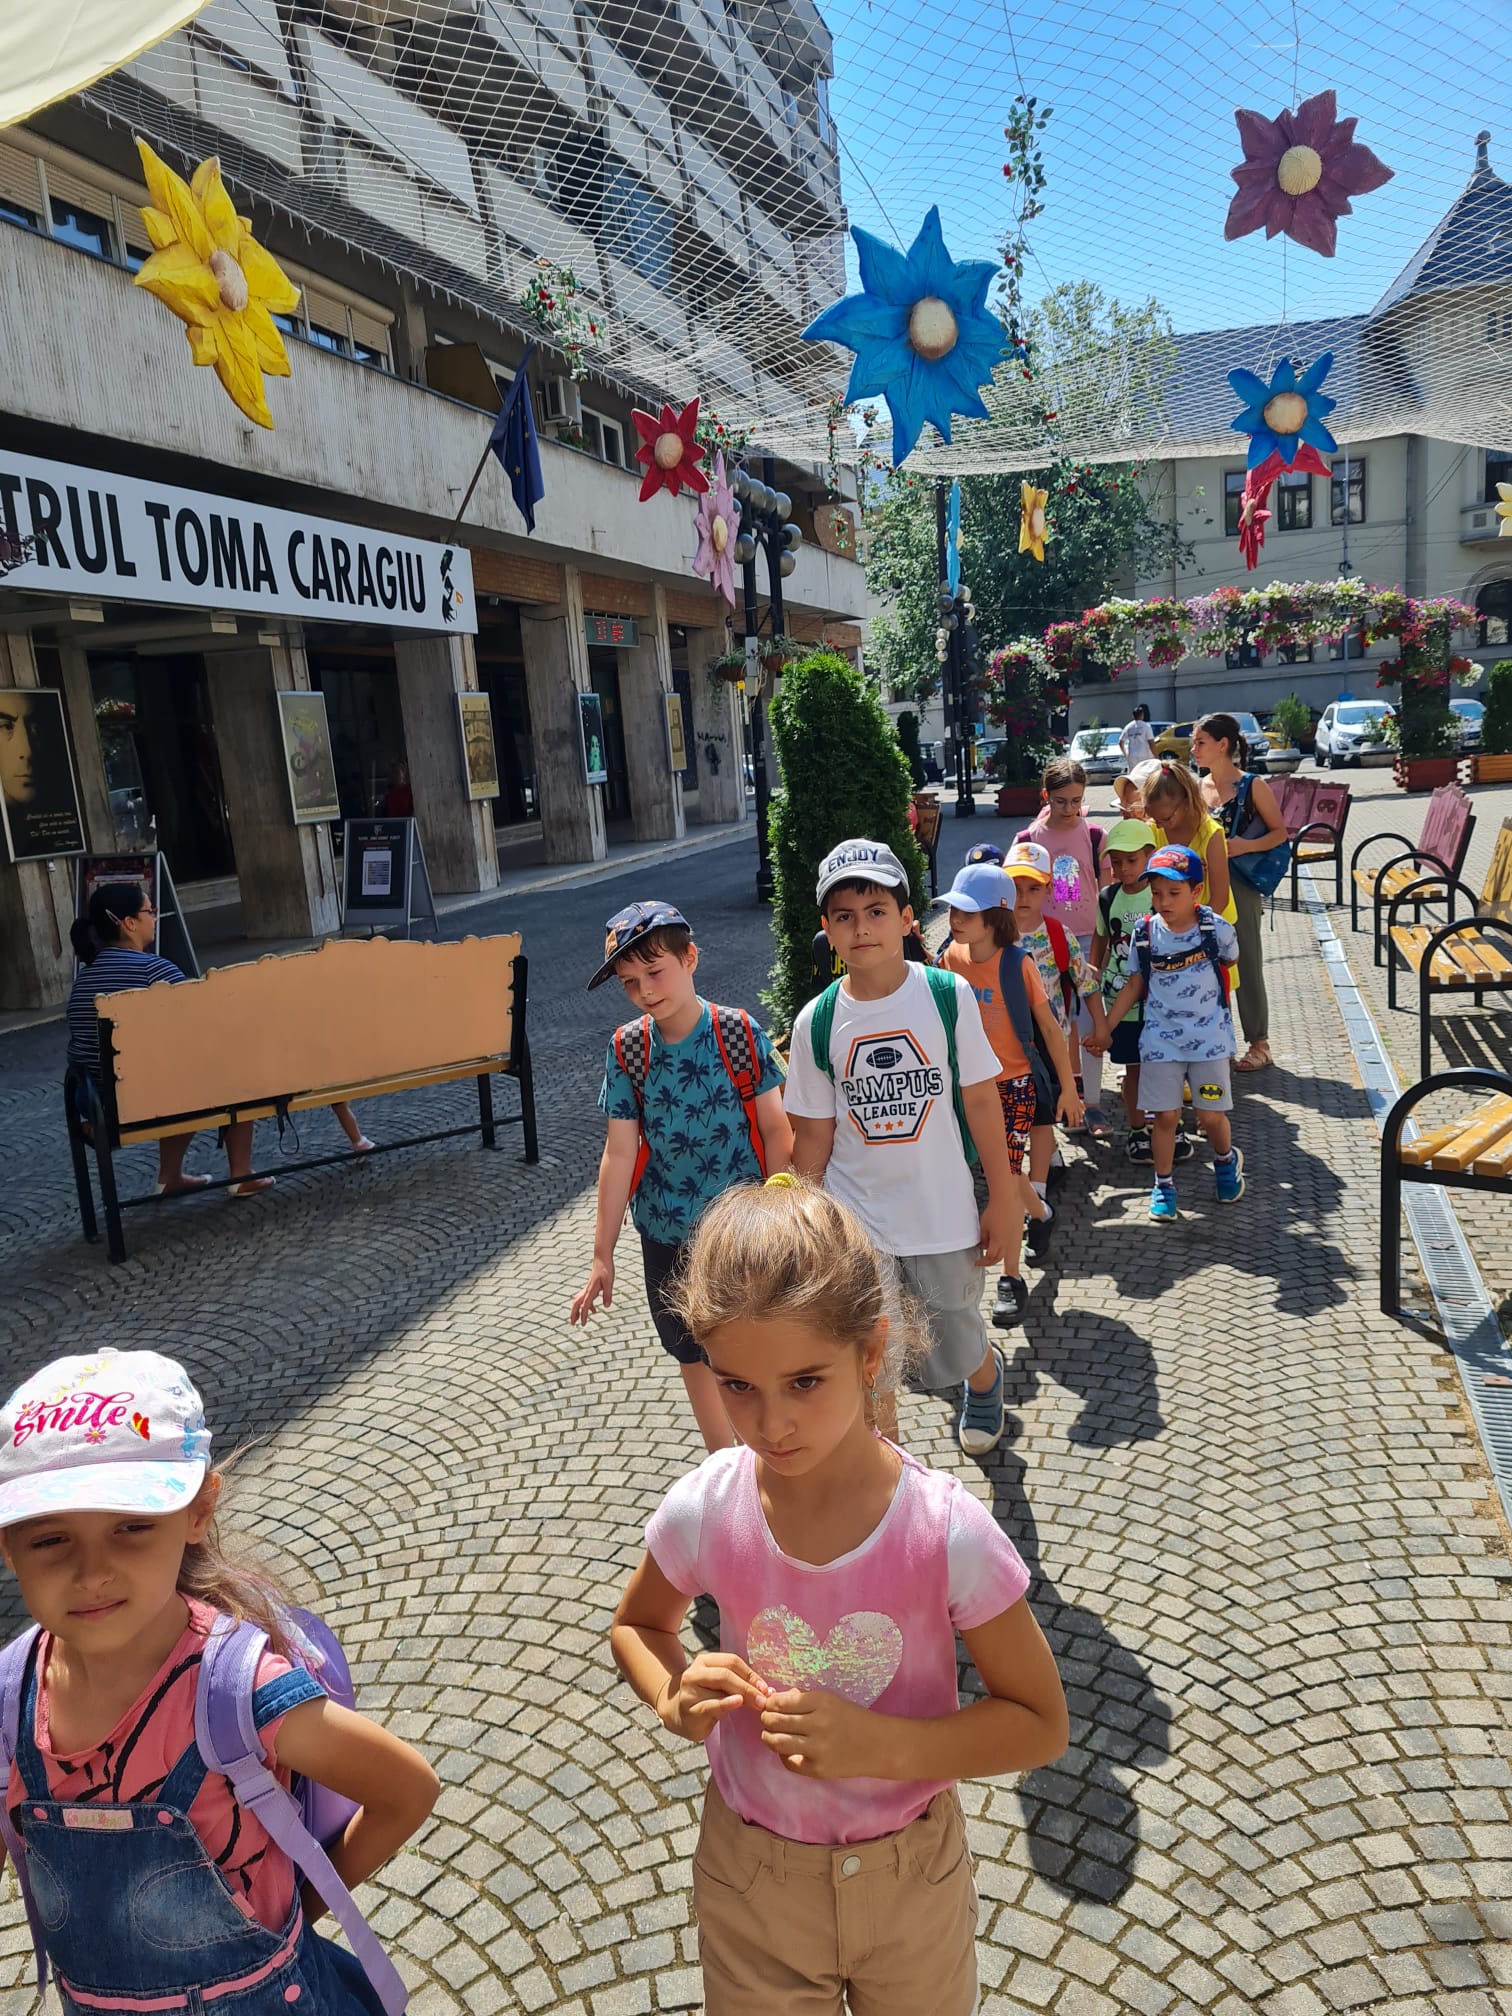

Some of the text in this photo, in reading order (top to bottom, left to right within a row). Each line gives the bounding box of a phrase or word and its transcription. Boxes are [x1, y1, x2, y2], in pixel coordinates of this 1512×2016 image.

[145, 500, 279, 595] TOMA
[288, 530, 426, 613] CARAGIU
[828, 847, 879, 872] ENJOY
[841, 1067, 944, 1106] CAMPUS
[863, 1102, 917, 1121] LEAGUE
[14, 1391, 135, 1448] Smile
